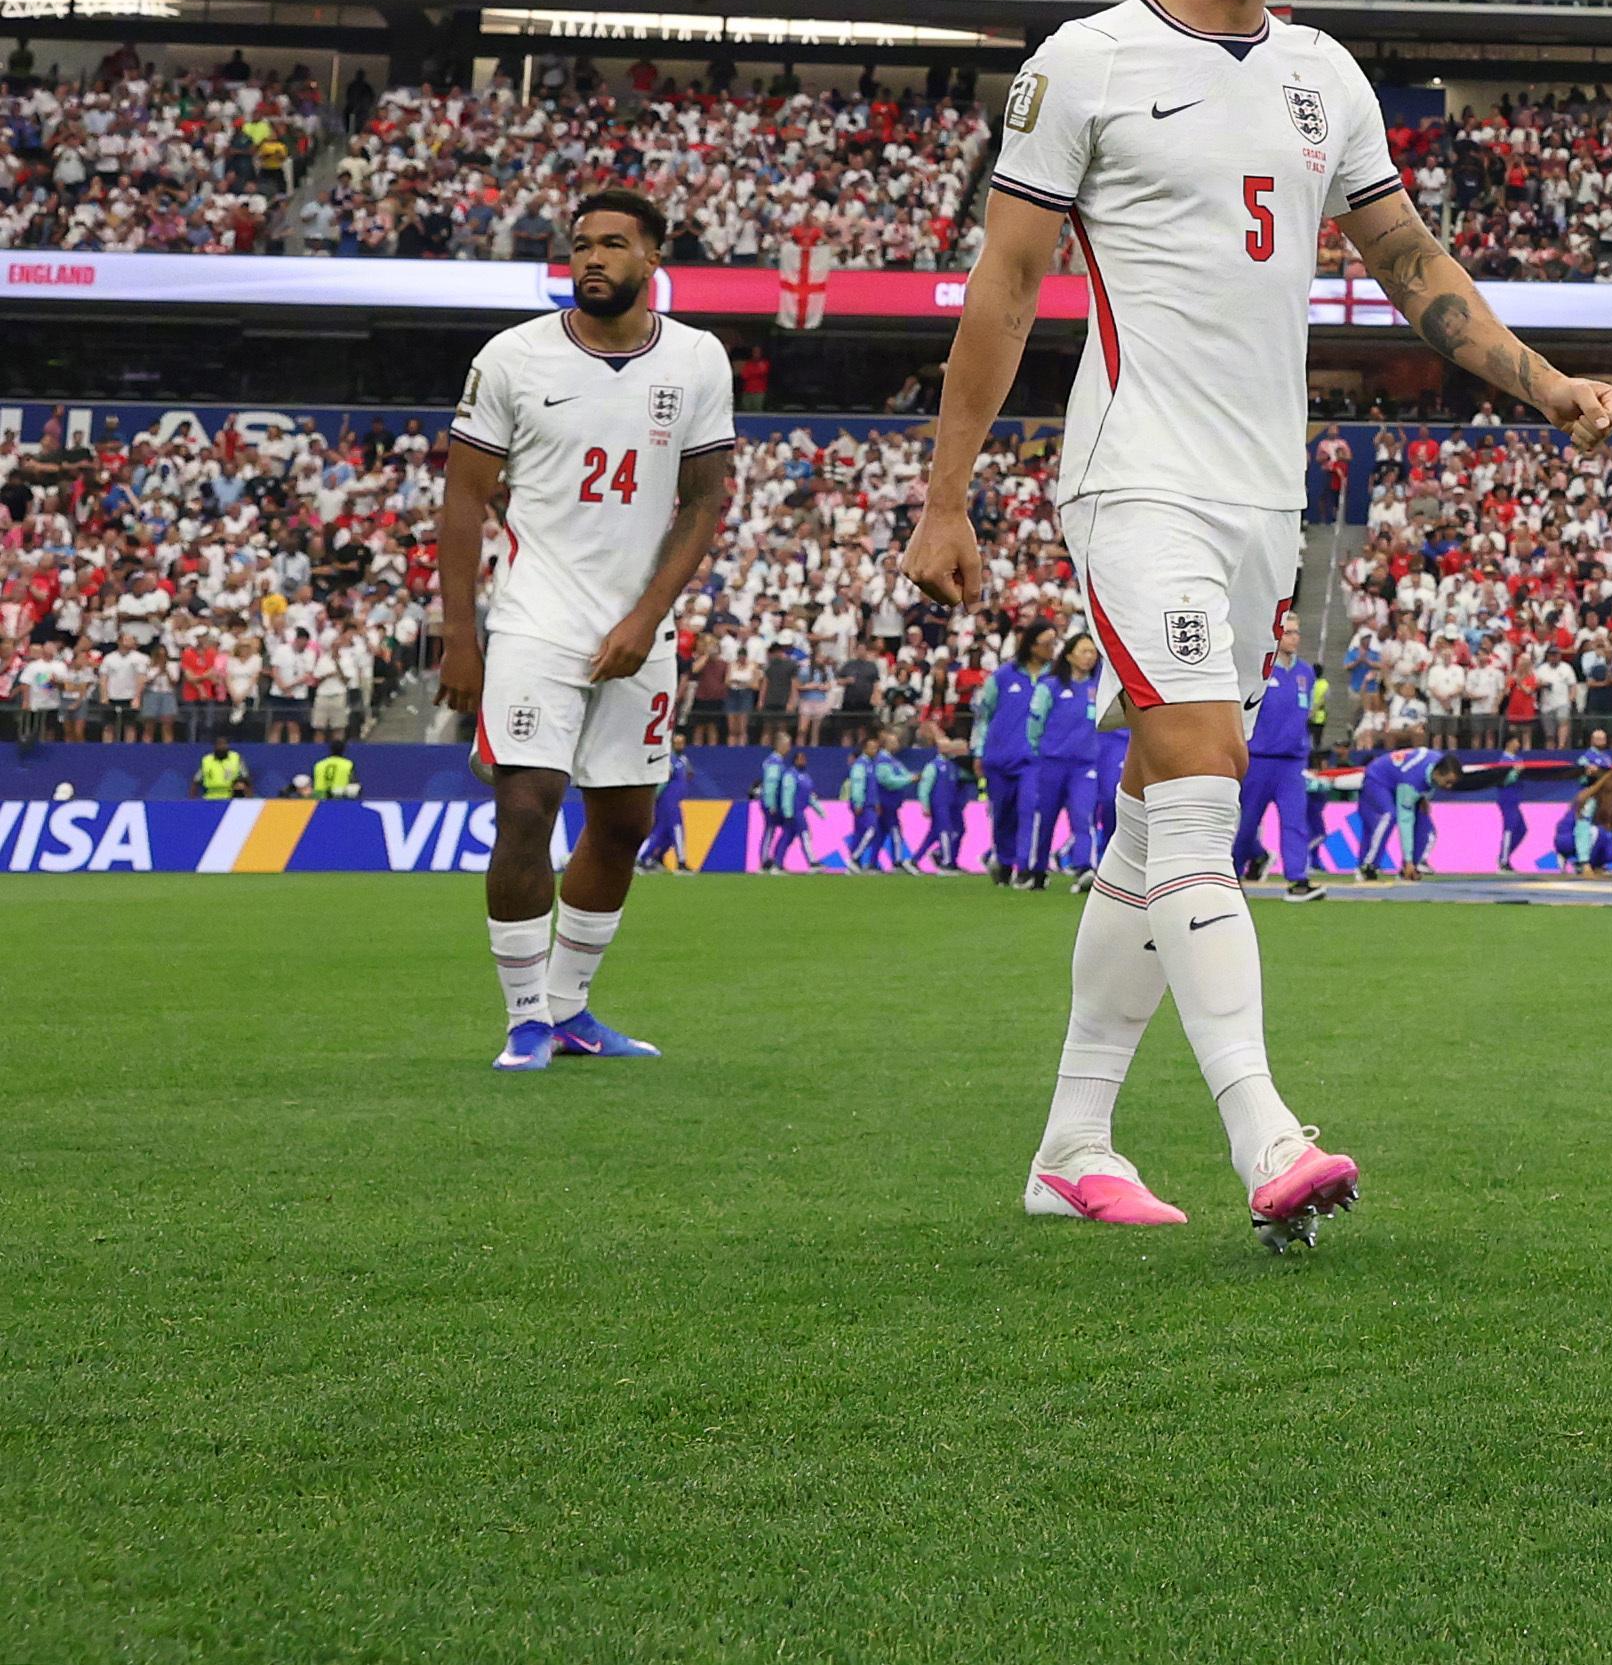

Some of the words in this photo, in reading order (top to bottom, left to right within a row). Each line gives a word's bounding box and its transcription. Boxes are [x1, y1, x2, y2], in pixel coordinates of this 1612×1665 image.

[1243, 175, 1275, 262] 5
[8, 264, 95, 286] ENGLAND
[579, 447, 639, 504] 24
